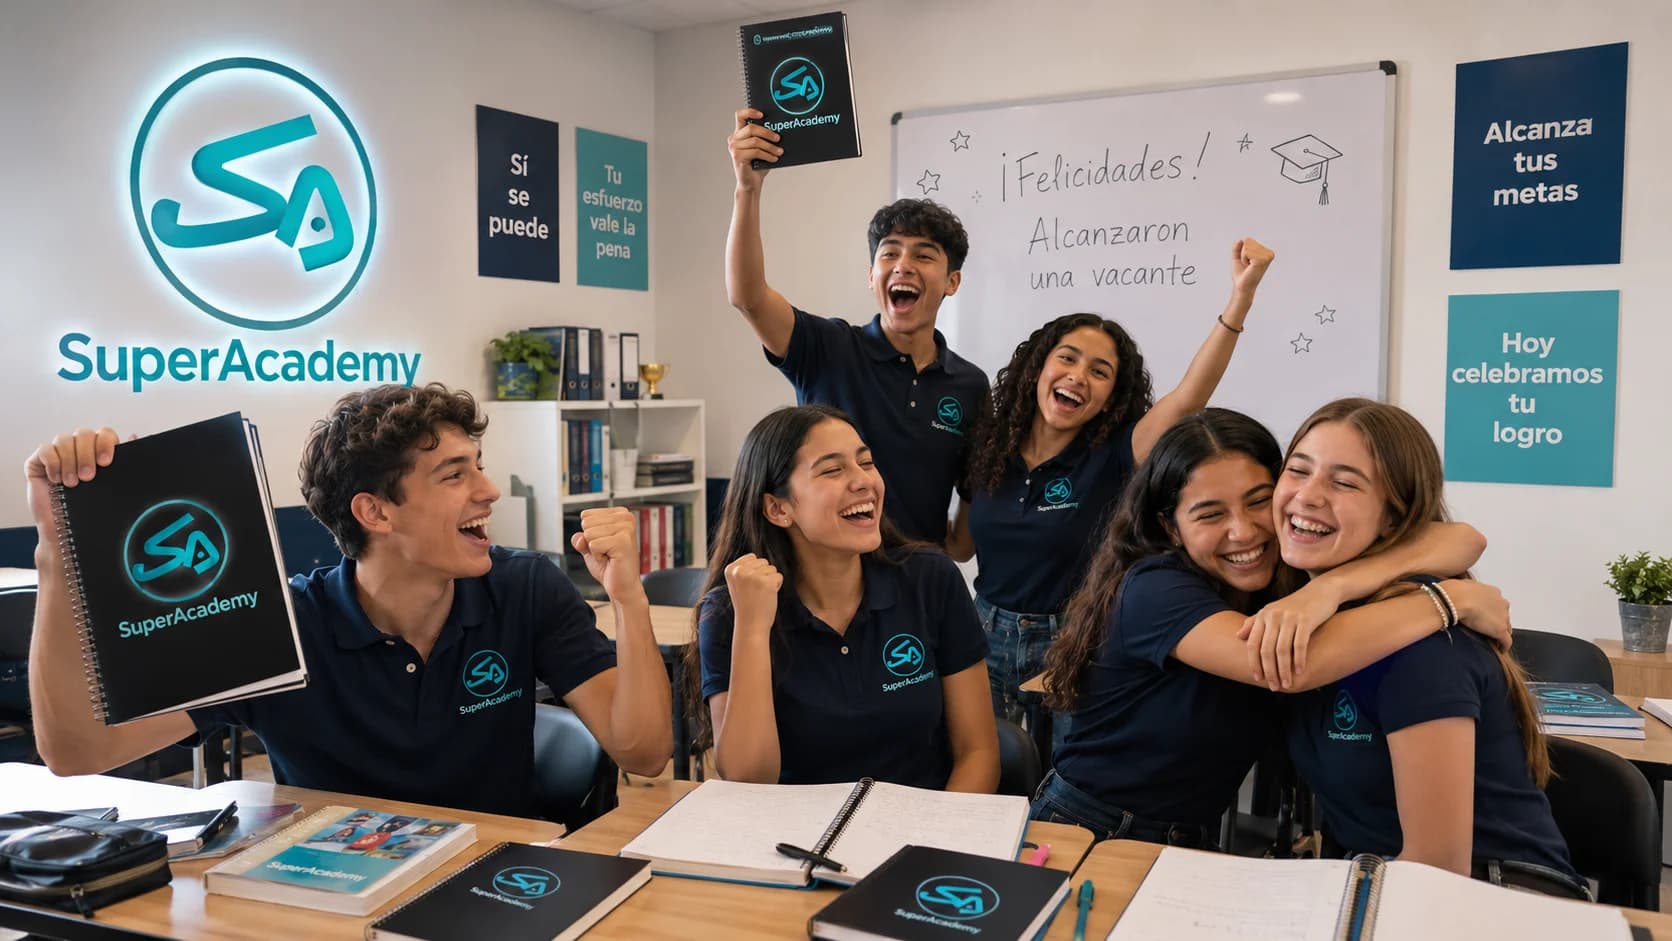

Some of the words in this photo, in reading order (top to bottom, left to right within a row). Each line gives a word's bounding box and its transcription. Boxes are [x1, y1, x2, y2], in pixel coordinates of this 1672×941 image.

[764, 113, 840, 132] SuperAcademy
[1483, 117, 1593, 144] Alcanza
[510, 153, 528, 176] Sí
[604, 164, 622, 184] Tu
[1513, 152, 1558, 173] tus
[508, 188, 530, 206] se
[583, 189, 643, 213] esfuerzo
[1493, 182, 1579, 206] metas
[489, 215, 549, 239] puede
[590, 214, 620, 233] vale
[623, 217, 636, 236] la
[1028, 216, 1190, 255] Alcanzaron
[596, 242, 630, 259] pena
[1030, 270, 1074, 289] una
[1092, 254, 1197, 287] vacante
[1502, 332, 1555, 358] Hoy
[57, 333, 421, 392] SuperAcademy
[1452, 362, 1604, 383] celebramos
[1508, 394, 1536, 413] tu
[1493, 421, 1563, 448] logro
[118, 591, 258, 638] SuperAcademy
[459, 688, 522, 715] SuperAcademy
[266, 860, 367, 882] SuperAcademy
[894, 908, 982, 935] SuperAcademy
